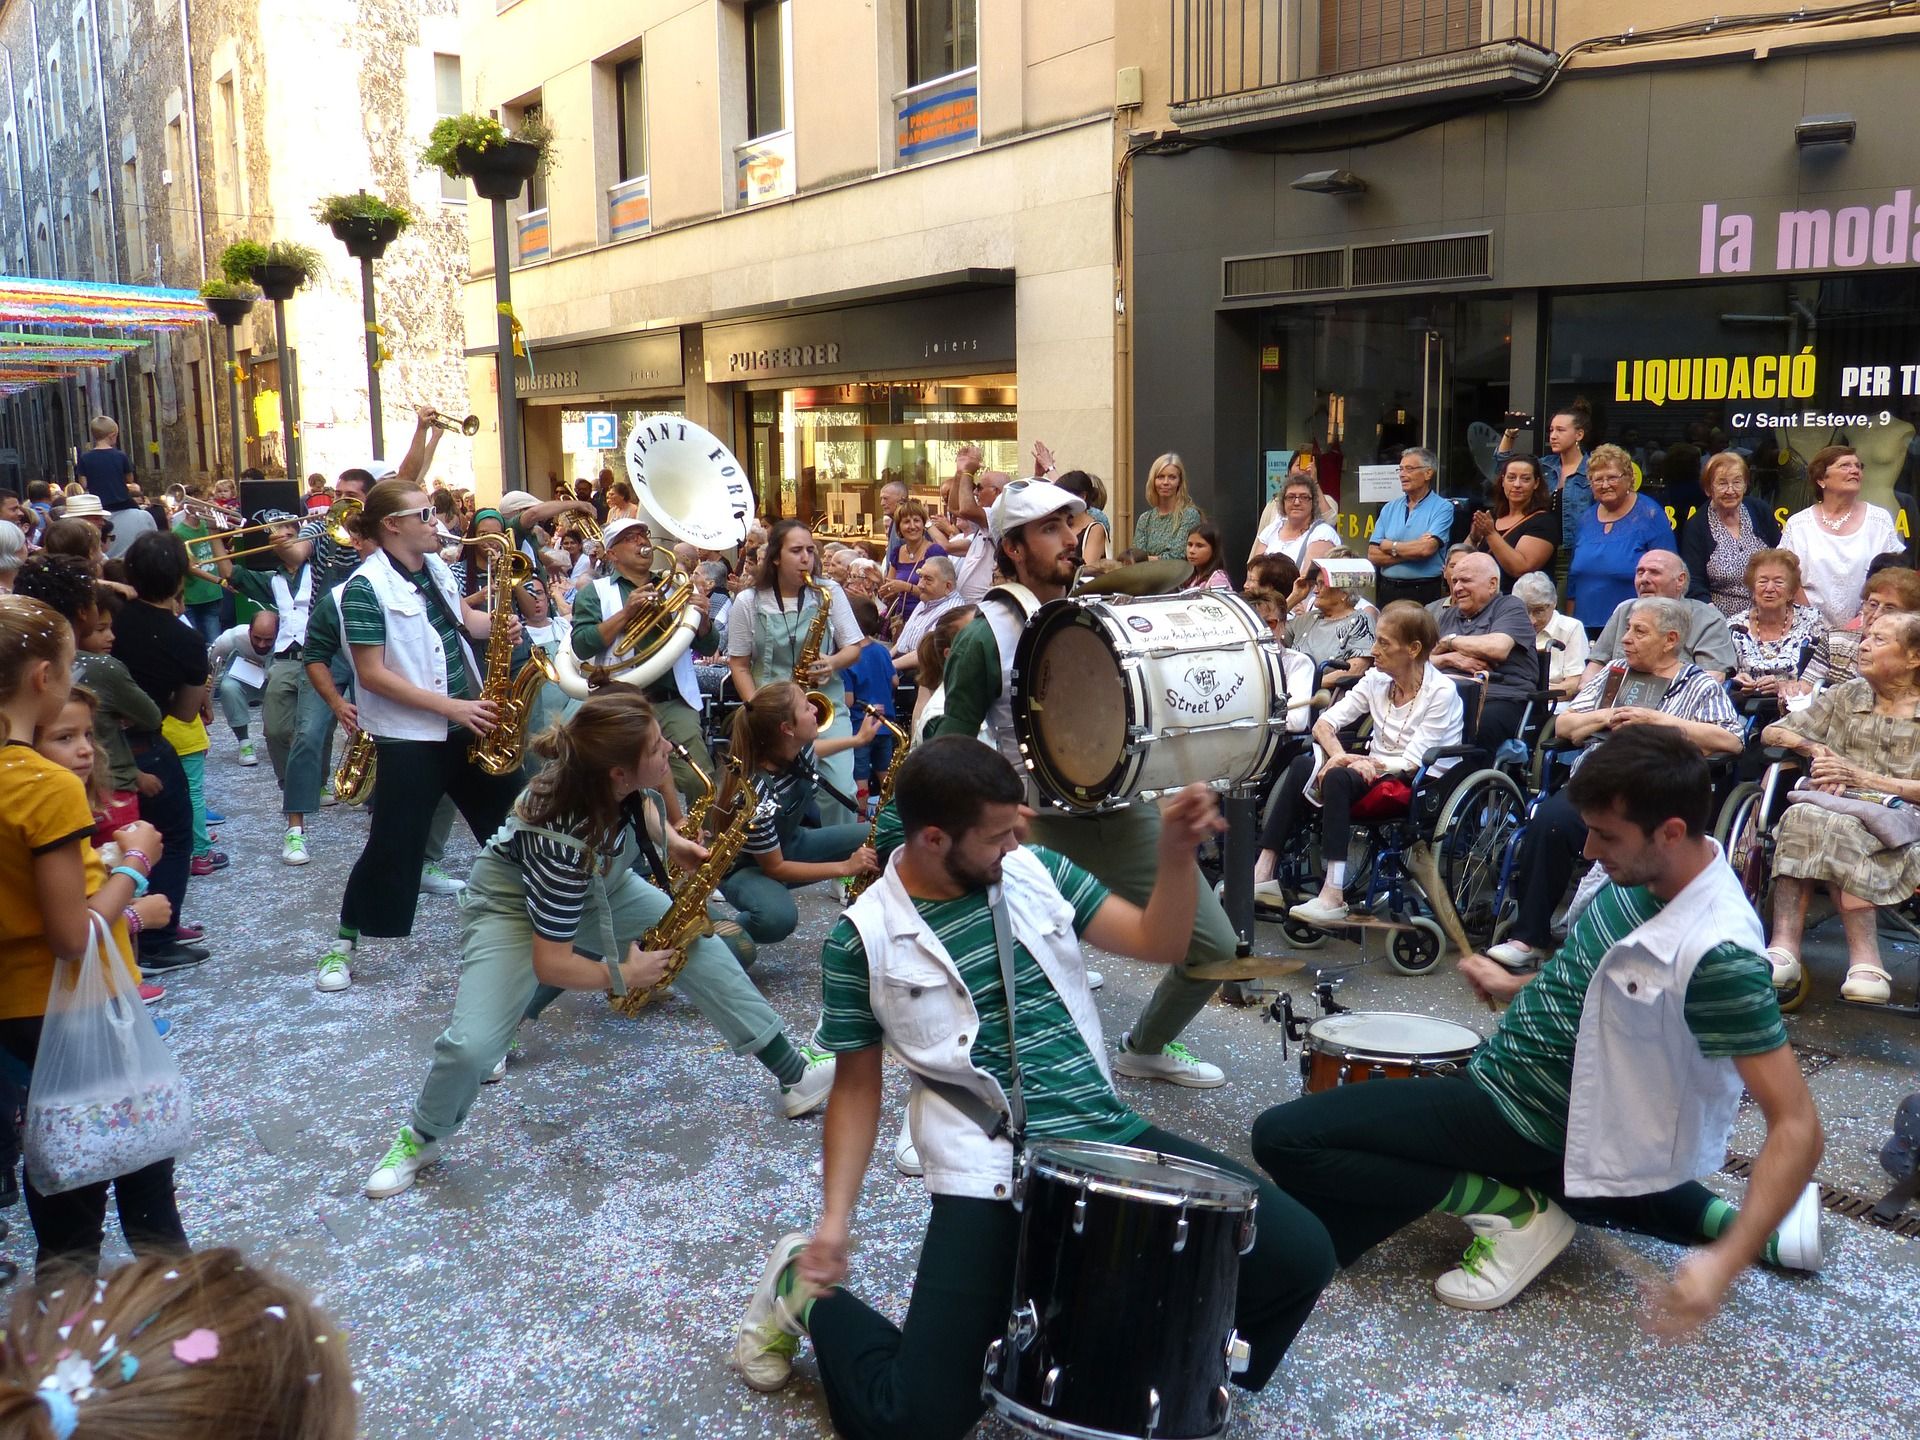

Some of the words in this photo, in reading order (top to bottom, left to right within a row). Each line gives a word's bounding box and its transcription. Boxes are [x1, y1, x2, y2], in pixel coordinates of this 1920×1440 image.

[1700, 204, 1753, 273] la
[1776, 189, 1920, 271] mod
[729, 343, 839, 371] PUIGFERRER
[925, 339, 977, 357] joiers
[1615, 346, 1816, 406] LIQUIDACIÓ
[1841, 365, 1891, 397] PER
[1900, 365, 1920, 396] T
[591, 418, 611, 445] P
[1731, 413, 1752, 428] C/
[1756, 412, 1798, 428] Sant
[1803, 411, 1873, 428] Esteve,
[1879, 411, 1891, 426] 9
[633, 422, 687, 486] BUFANT
[708, 447, 748, 511] FORT
[1165, 688, 1210, 713] Street
[1214, 672, 1245, 711] Band
